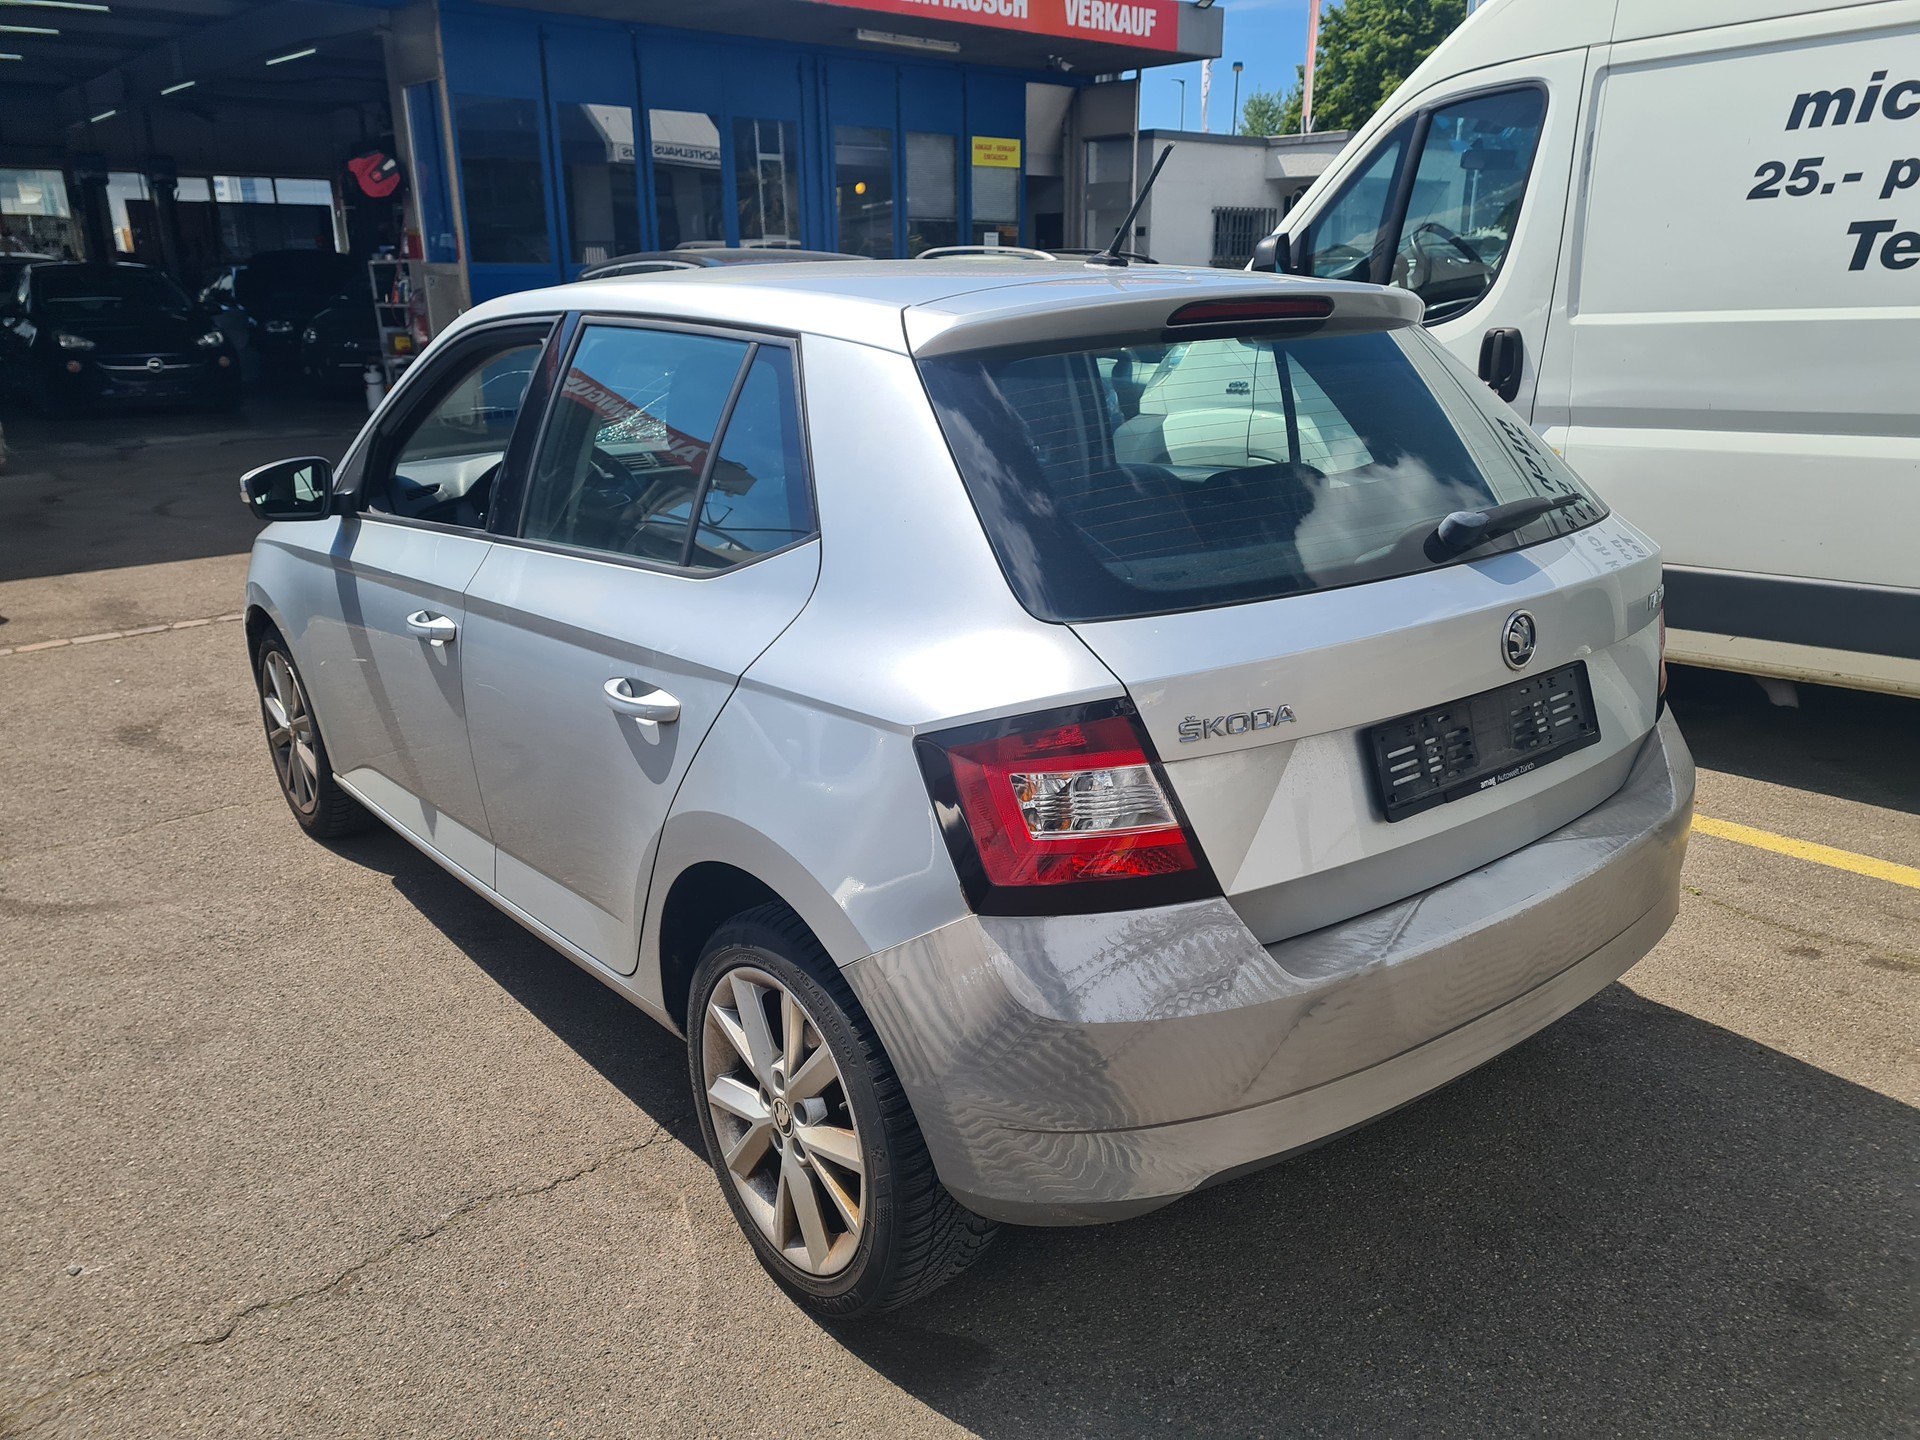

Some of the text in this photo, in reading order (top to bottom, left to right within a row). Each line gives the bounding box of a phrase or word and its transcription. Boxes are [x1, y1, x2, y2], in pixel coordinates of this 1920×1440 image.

[1065, 0, 1157, 37] VERKAUF
[1785, 69, 1920, 131] mic
[1746, 156, 1864, 201] 25.-
[1846, 218, 1920, 272] Te
[1178, 703, 1297, 743] ŠKODA
[1480, 761, 1536, 789] amag Autowelt Zürich
